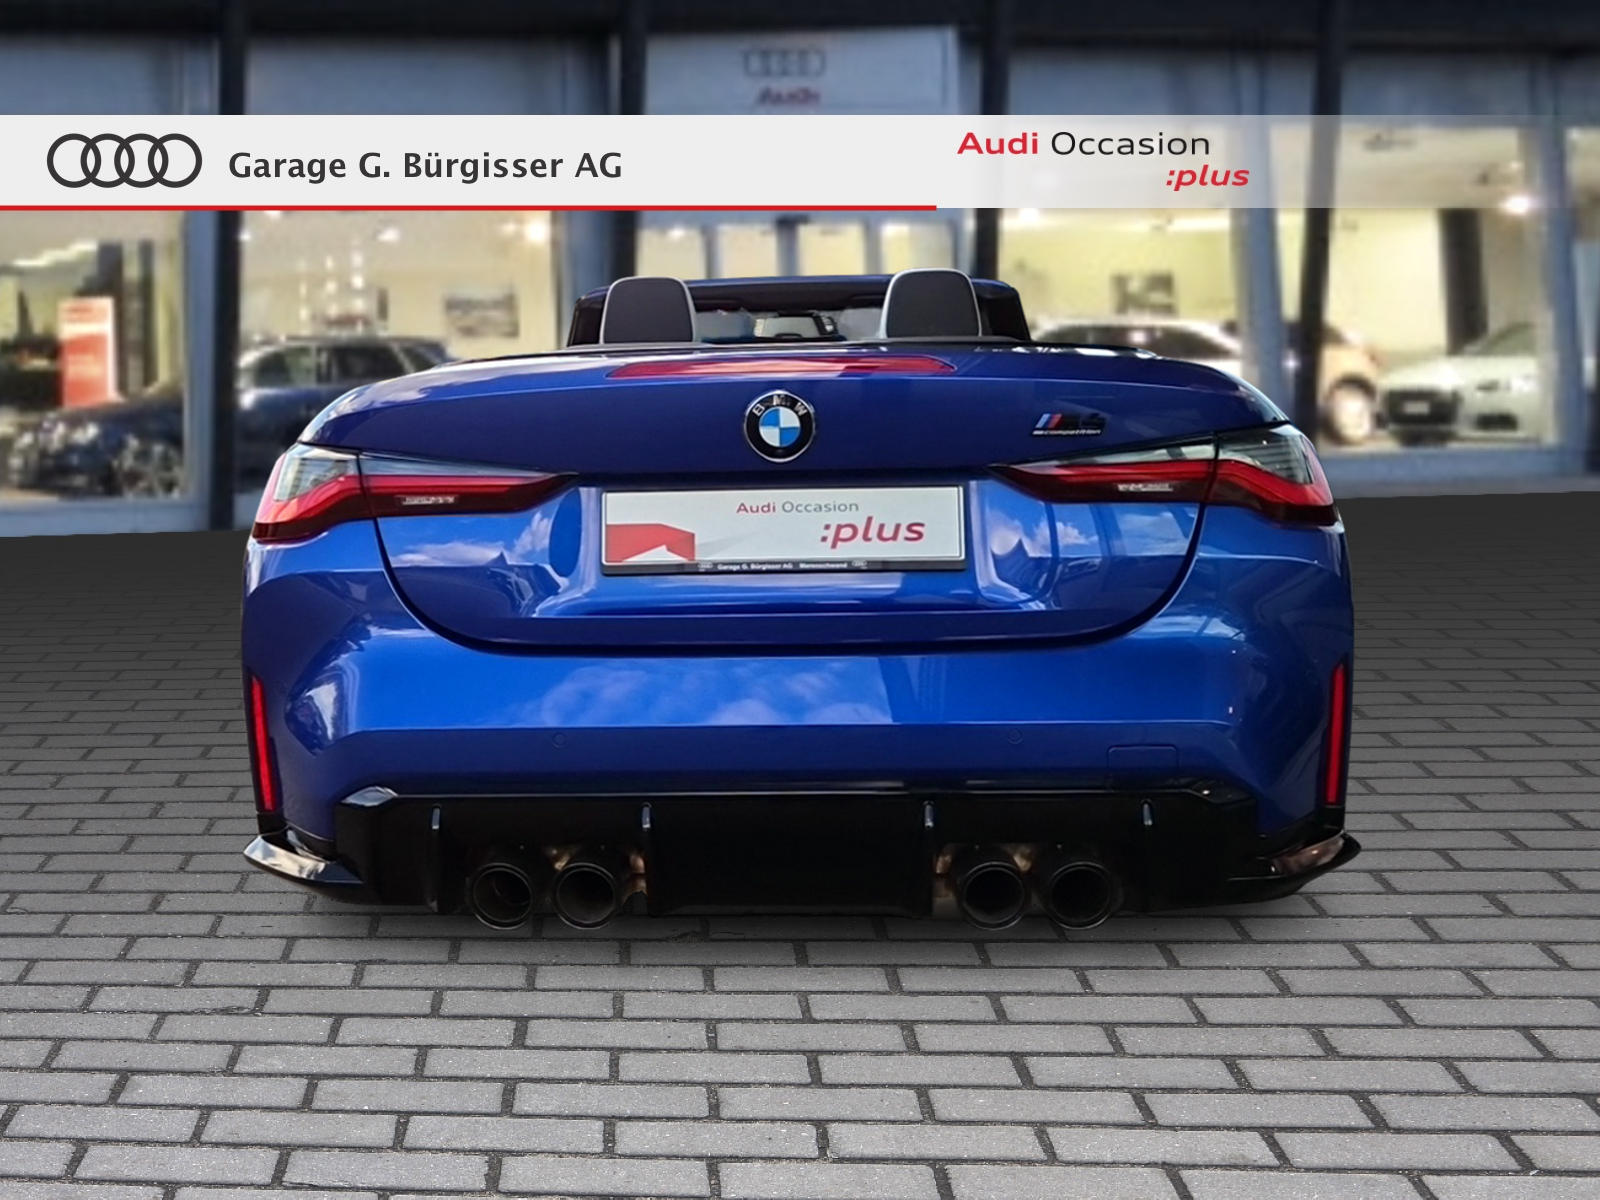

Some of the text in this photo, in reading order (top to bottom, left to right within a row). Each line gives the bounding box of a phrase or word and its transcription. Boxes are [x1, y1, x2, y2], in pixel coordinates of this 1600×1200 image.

[752, 394, 807, 416] BMW
[736, 500, 860, 514] Audi Occasion
[820, 516, 926, 550] :plus
[717, 563, 740, 571] Garage
[783, 562, 794, 570] AG
